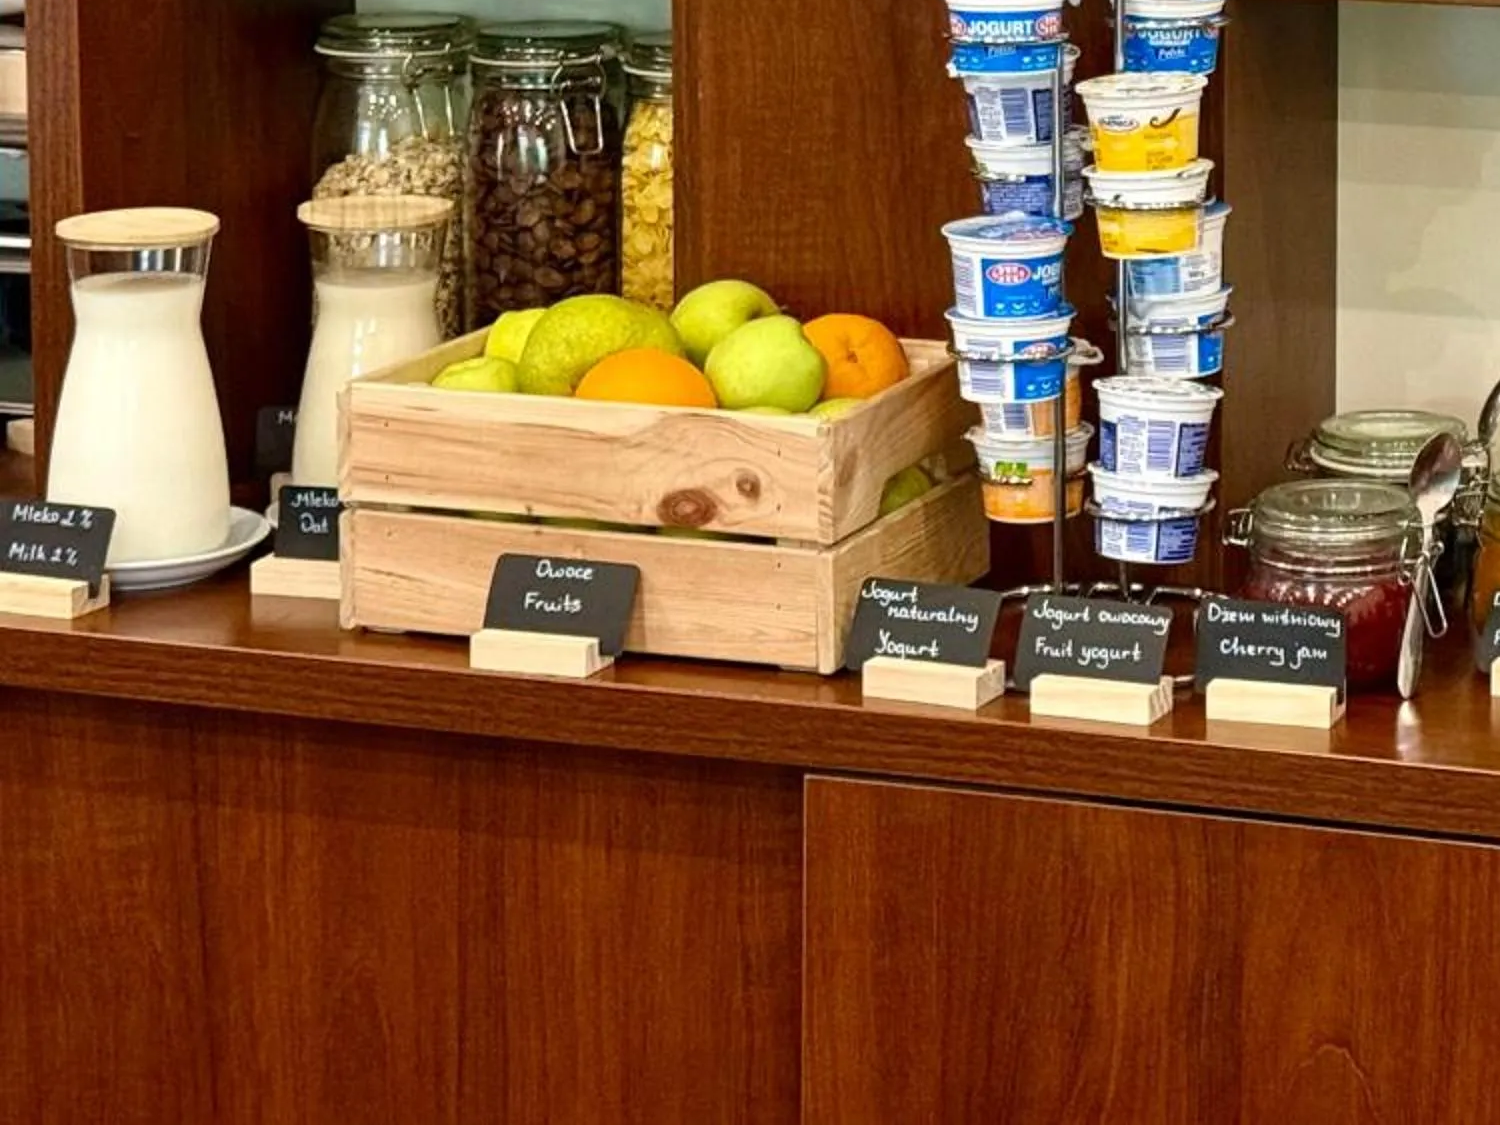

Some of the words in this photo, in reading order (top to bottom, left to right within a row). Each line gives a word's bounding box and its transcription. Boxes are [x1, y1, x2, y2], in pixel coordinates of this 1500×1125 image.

[967, 19, 1035, 36] JOGURT
[12, 502, 60, 524] Mleko
[8, 541, 46, 562] Milk
[535, 559, 594, 581] Owoce
[523, 592, 584, 614] Fruits
[861, 580, 918, 607] Jogurt
[887, 605, 980, 633] naturalny
[1033, 599, 1090, 630] Jogurt
[1098, 610, 1171, 636] owocowy
[874, 628, 940, 659] Yogurt
[1034, 636, 1073, 659] Fruit
[1077, 642, 1143, 669] yogurt
[1219, 636, 1285, 666] Cherry
[1288, 642, 1328, 670] jam
